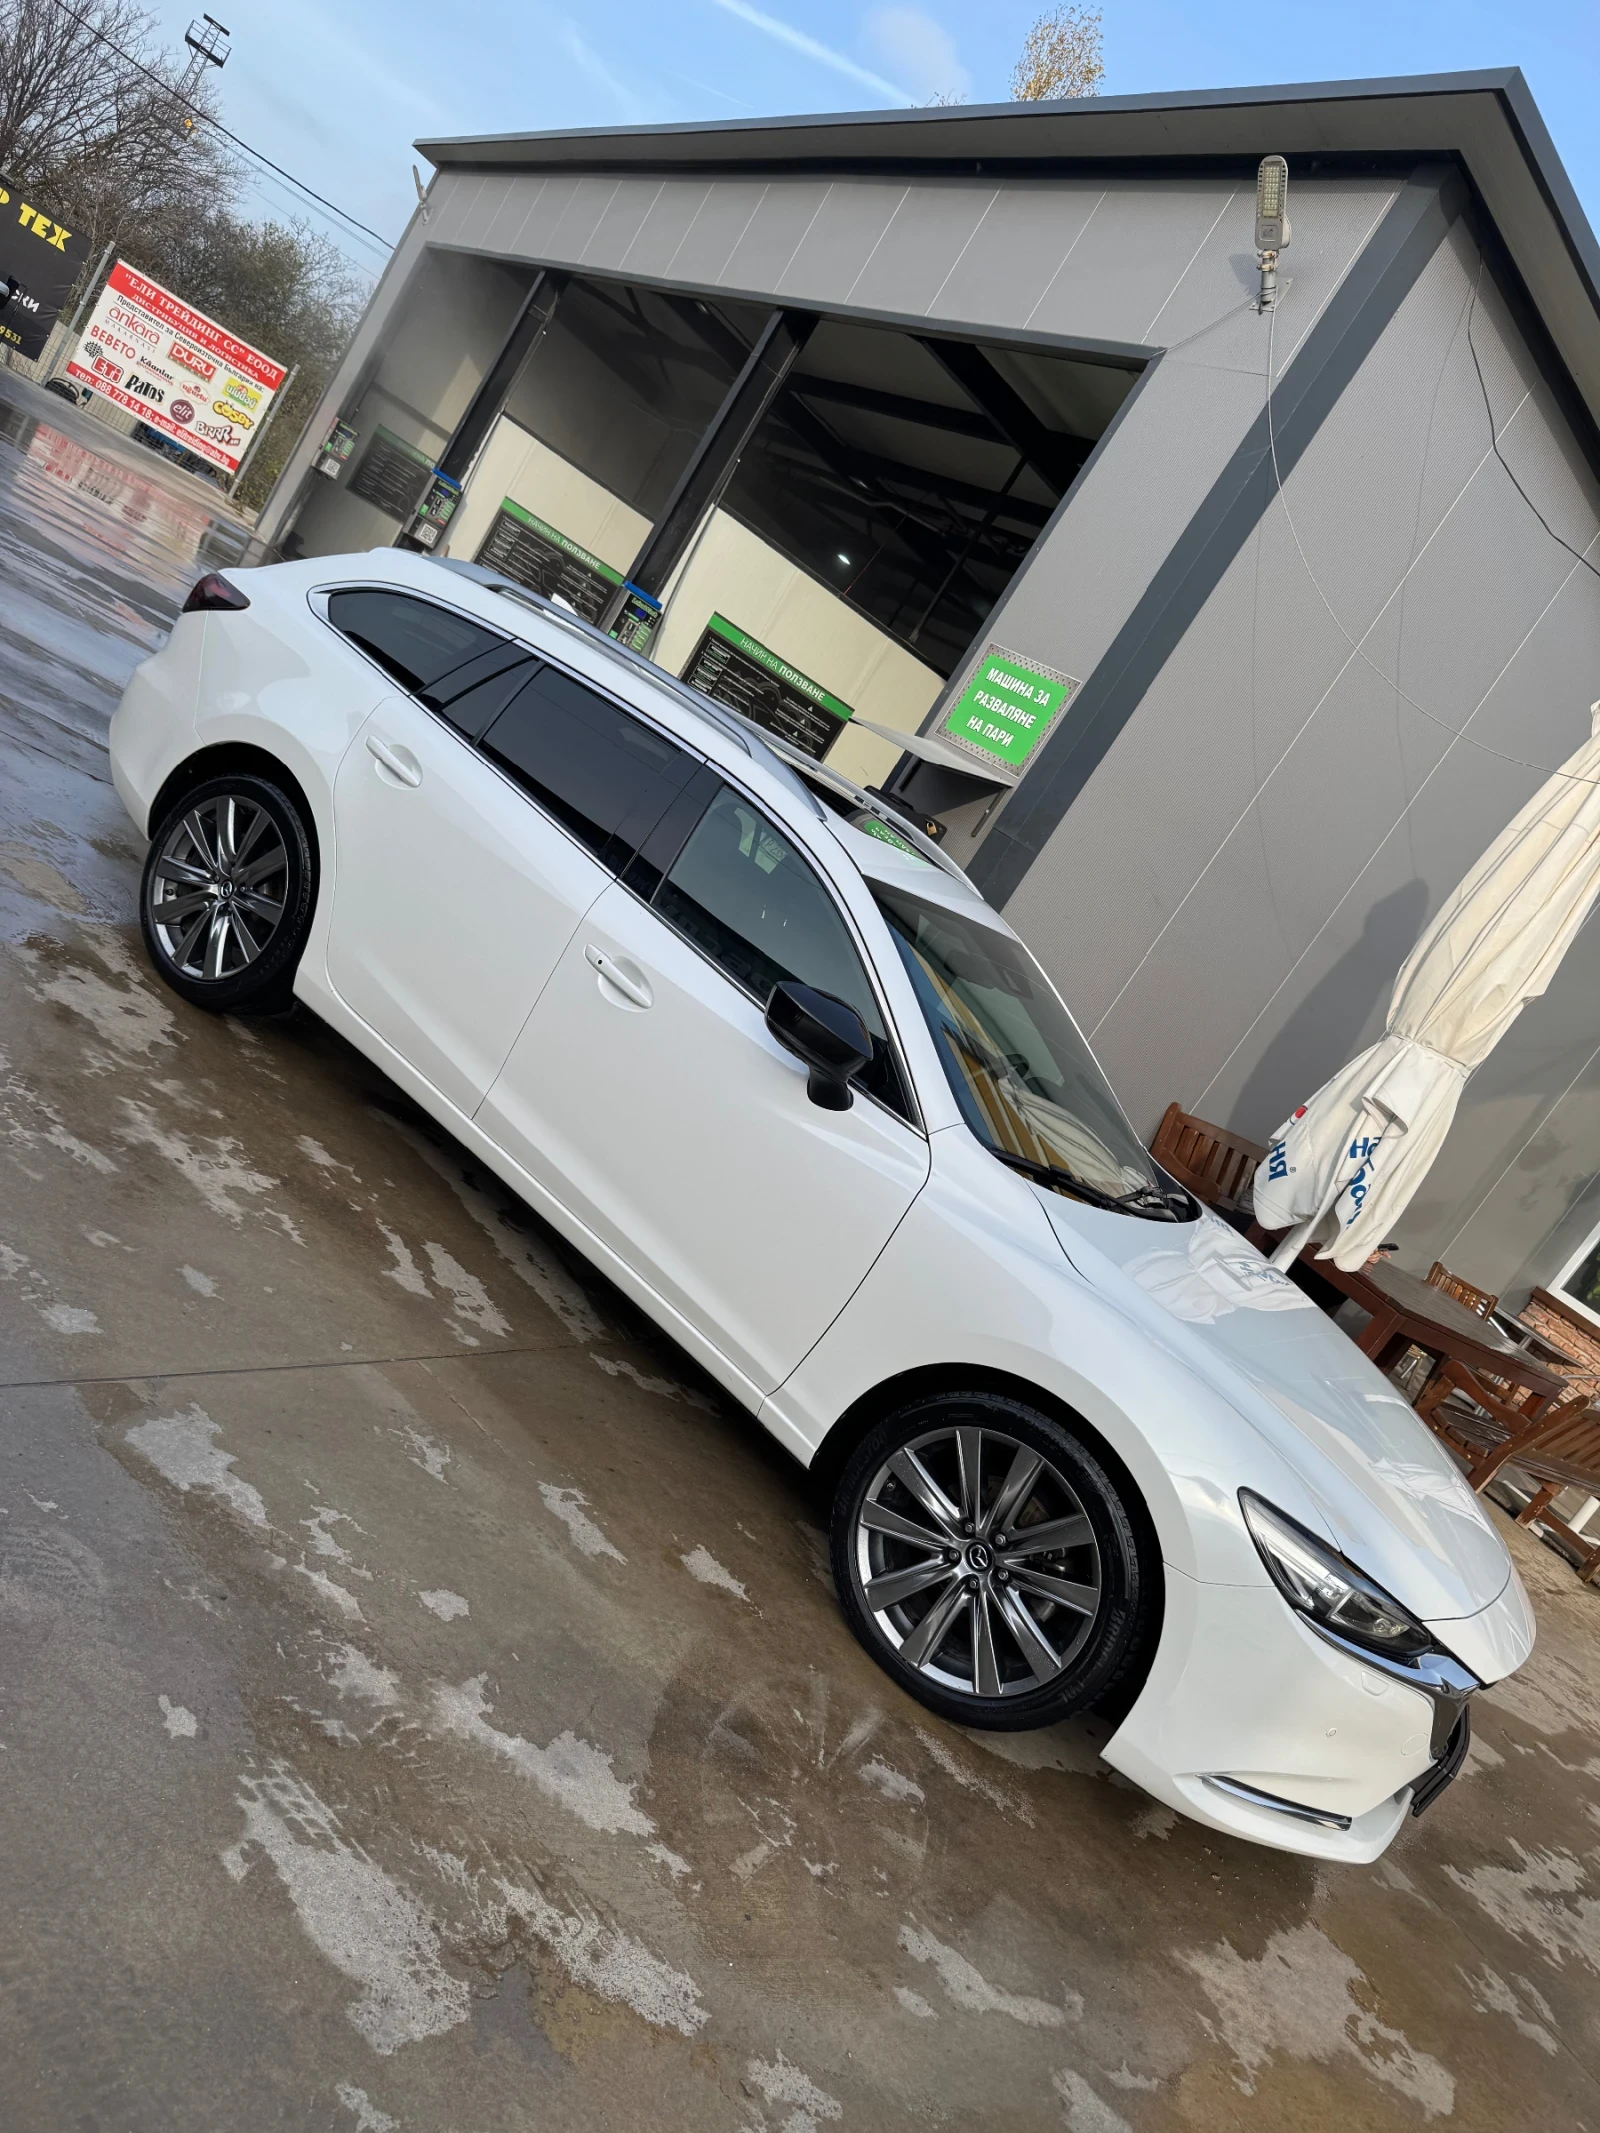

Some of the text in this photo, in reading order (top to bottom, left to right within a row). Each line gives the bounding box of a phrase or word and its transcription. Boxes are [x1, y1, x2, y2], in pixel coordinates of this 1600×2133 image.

[90, 325, 137, 360] BEBETO
[110, 306, 161, 345] ankara
[117, 295, 165, 330] Представител
[174, 332, 223, 367] Североизточна
[224, 364, 253, 386] България
[131, 294, 198, 339] ДИСТРИБУЦИЯ
[208, 344, 257, 379] ЛОГИСТИКА
[158, 296, 222, 342] ТРЕЙДИНГ
[245, 353, 278, 380] ЕООД
[171, 345, 214, 377] DURU
[75, 369, 94, 384] тел:
[94, 379, 112, 394] 088
[111, 389, 129, 404] 778
[128, 399, 141, 411] 14
[154, 417, 176, 433] e-mail:
[173, 406, 193, 419] elit
[213, 401, 254, 430] COSBY
[527, 517, 601, 570] НАЧИН НА ПОЛЗВАНЕ
[740, 637, 826, 702] НАЧИН НА ПОЛЗВАНЕ
[985, 667, 1051, 707] МАШИНА ЗА
[973, 690, 1037, 730] РАЗВАЛЯНЕ
[966, 715, 1015, 748] НА ПАРИ
